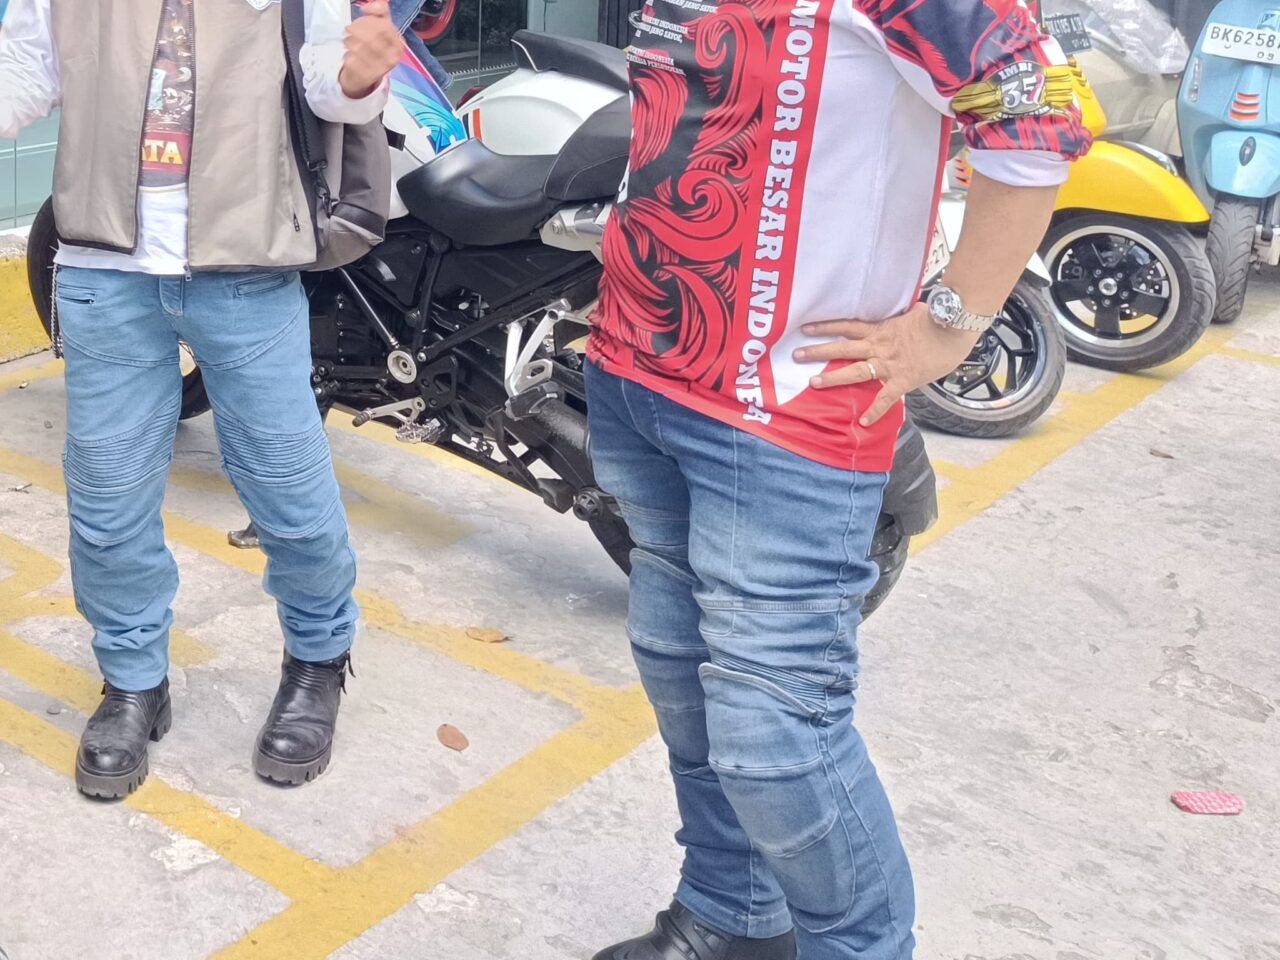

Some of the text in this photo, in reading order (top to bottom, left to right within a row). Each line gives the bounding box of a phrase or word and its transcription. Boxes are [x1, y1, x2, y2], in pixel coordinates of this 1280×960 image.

[1210, 26, 1280, 49] BK6258
[999, 62, 1033, 81] IMBI
[754, 137, 798, 261] BESAR
